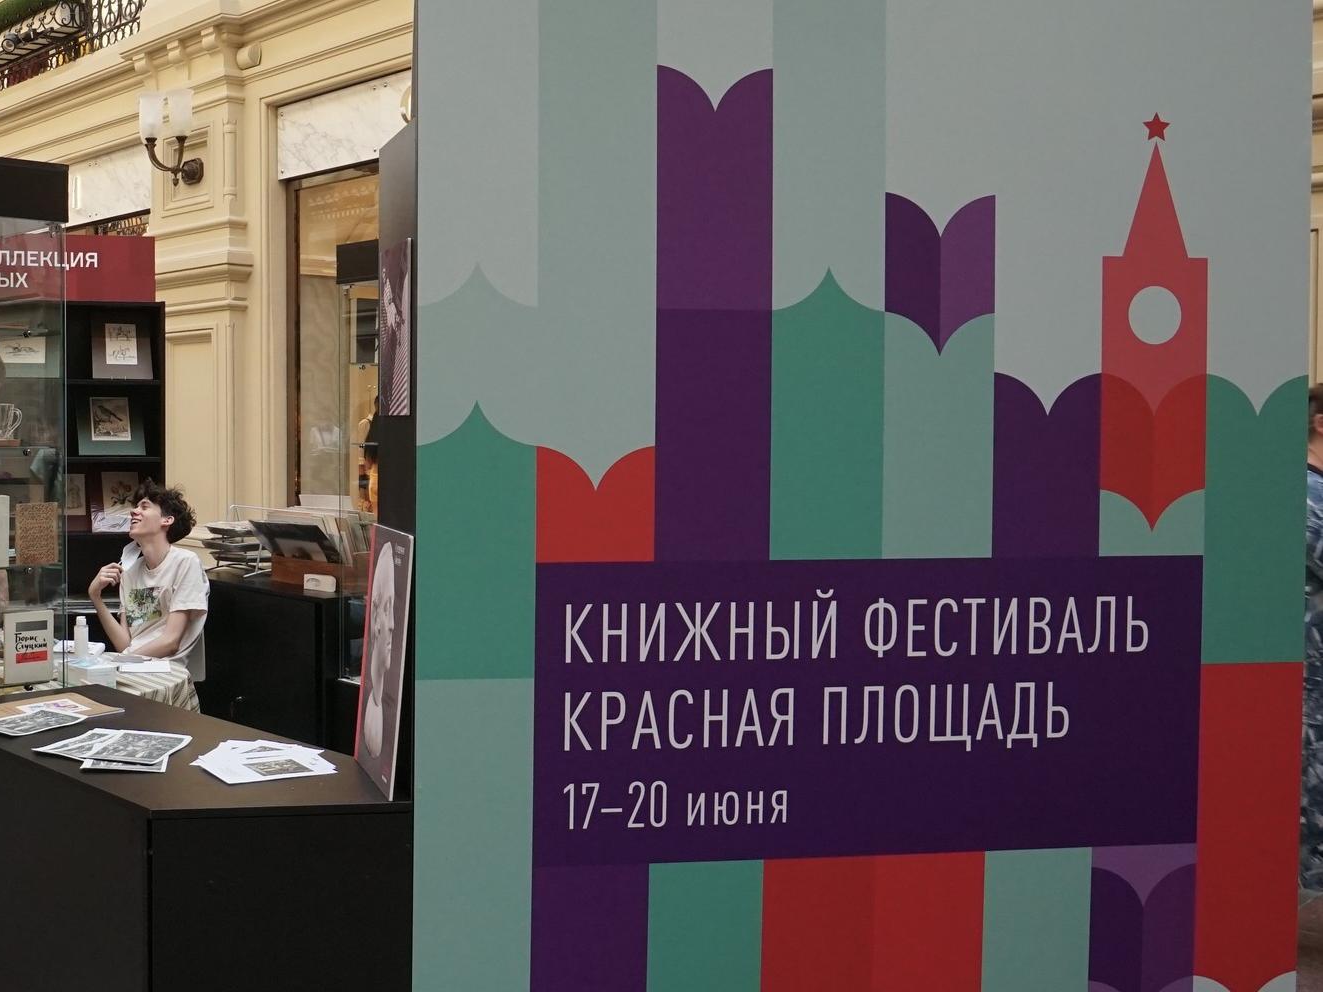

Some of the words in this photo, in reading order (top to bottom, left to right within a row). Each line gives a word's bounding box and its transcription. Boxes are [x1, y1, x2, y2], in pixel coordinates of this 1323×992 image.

[14, 632, 38, 644] Борис
[15, 638, 48, 656] Слуцкий
[565, 588, 838, 664] КНИЖНЫЙ
[863, 595, 1150, 657] ФЕСТИВАЛЬ
[563, 687, 796, 752] КРАСНАЯ
[822, 681, 1071, 752] ПЛОЩАДЬ
[563, 780, 668, 830] 17–20
[686, 789, 789, 827] июня
